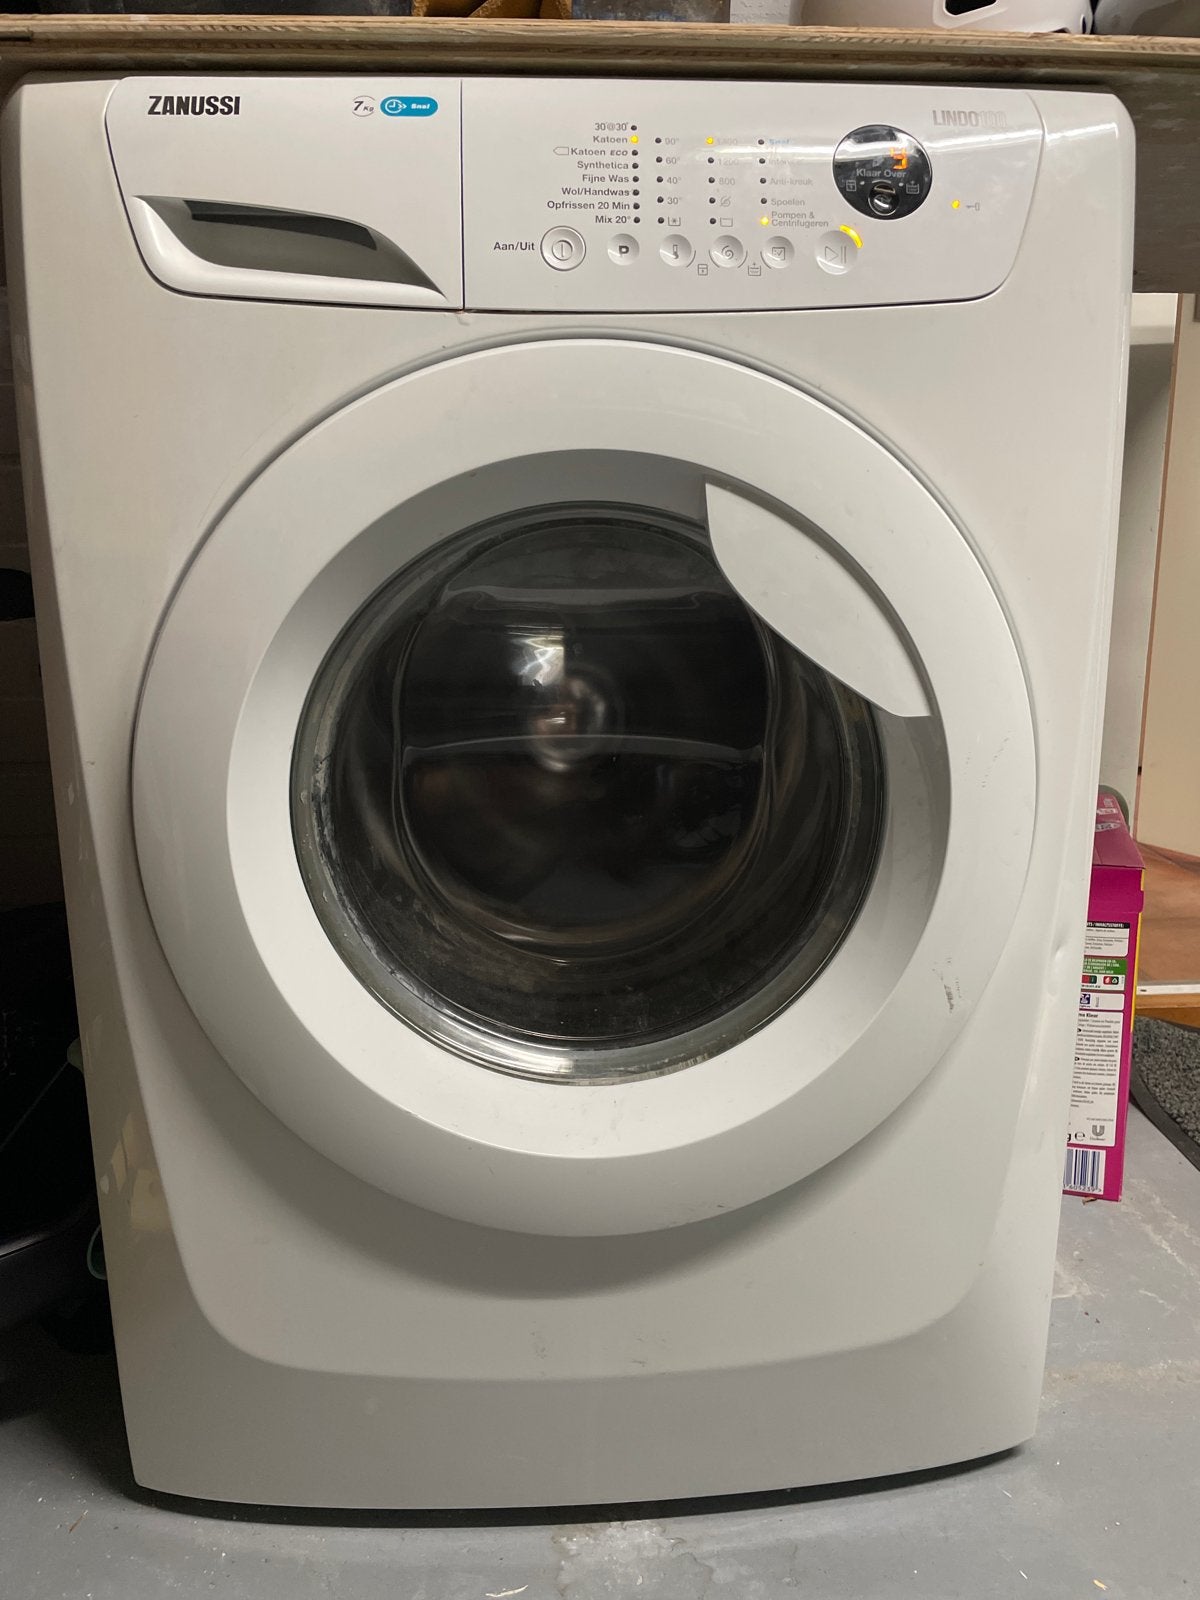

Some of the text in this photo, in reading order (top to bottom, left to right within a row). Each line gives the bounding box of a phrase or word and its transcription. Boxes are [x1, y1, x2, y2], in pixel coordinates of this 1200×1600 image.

[147, 95, 241, 115] ZANUSSI
[353, 100, 364, 111] 7
[593, 135, 628, 144] Katoen
[571, 147, 629, 157] Katoen ECO
[577, 160, 629, 171] Synthetica
[856, 168, 907, 179] Klaar Over
[582, 174, 629, 184] Fijne Was
[561, 187, 630, 197] Wol/Handwas
[547, 200, 631, 211] Opfrissen 20 Min
[770, 197, 806, 208] Spoelen
[595, 215, 631, 224] Mix 20°
[771, 211, 815, 221] Pompen &
[771, 219, 829, 229] Centrifugeren
[493, 241, 535, 251] Aan/Uit
[618, 245, 630, 256] P
